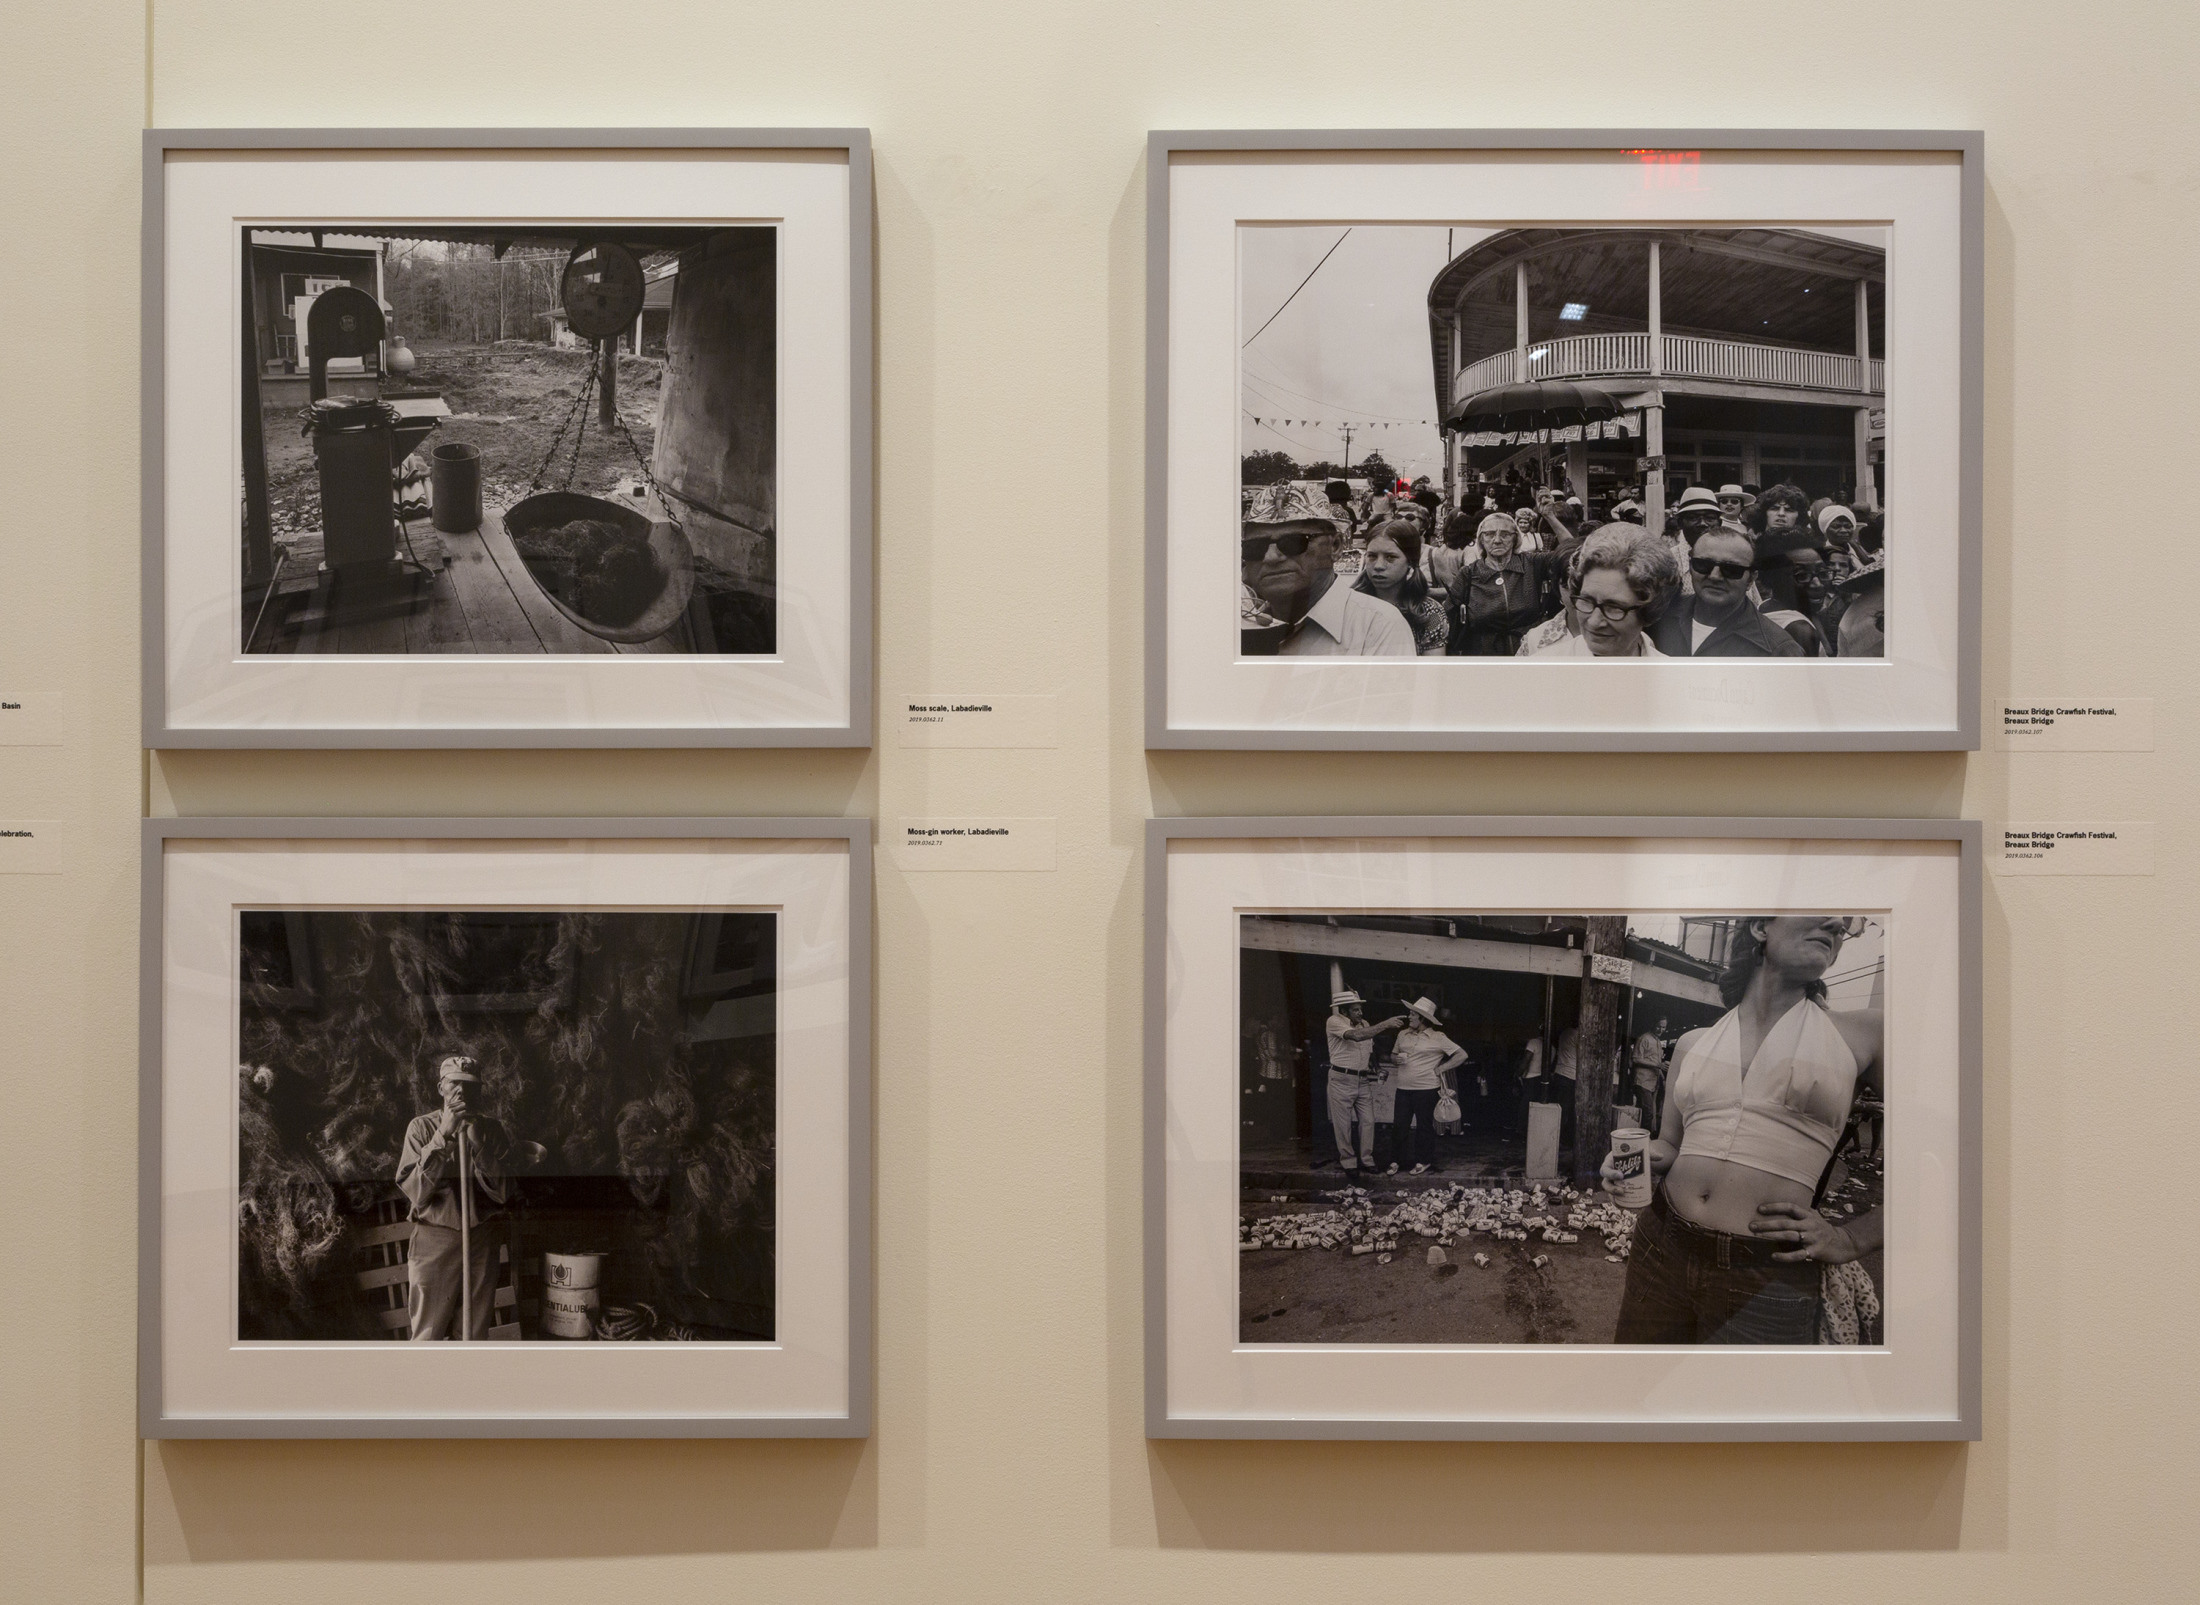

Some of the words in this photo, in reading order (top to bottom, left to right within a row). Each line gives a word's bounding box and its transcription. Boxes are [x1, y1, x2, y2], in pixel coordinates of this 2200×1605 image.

[1, 702, 21, 710] Basin
[2031, 708, 2054, 717] Bridge
[2056, 708, 2086, 716] Crawfish
[2088, 708, 2116, 717] Festival,
[2004, 717, 2029, 725] Breaux
[2031, 717, 2054, 726] Bridge
[907, 828, 939, 837] Moss-gin
[940, 828, 966, 836] worker,
[967, 828, 1009, 836] Labadieville
[2005, 832, 2030, 840] Breaux
[2031, 832, 2055, 841] Bridge
[2056, 832, 2087, 840] Crawfish
[2088, 832, 2118, 840] Festival,
[2005, 841, 2030, 849] Breaux
[2031, 841, 2055, 850] Bridge
